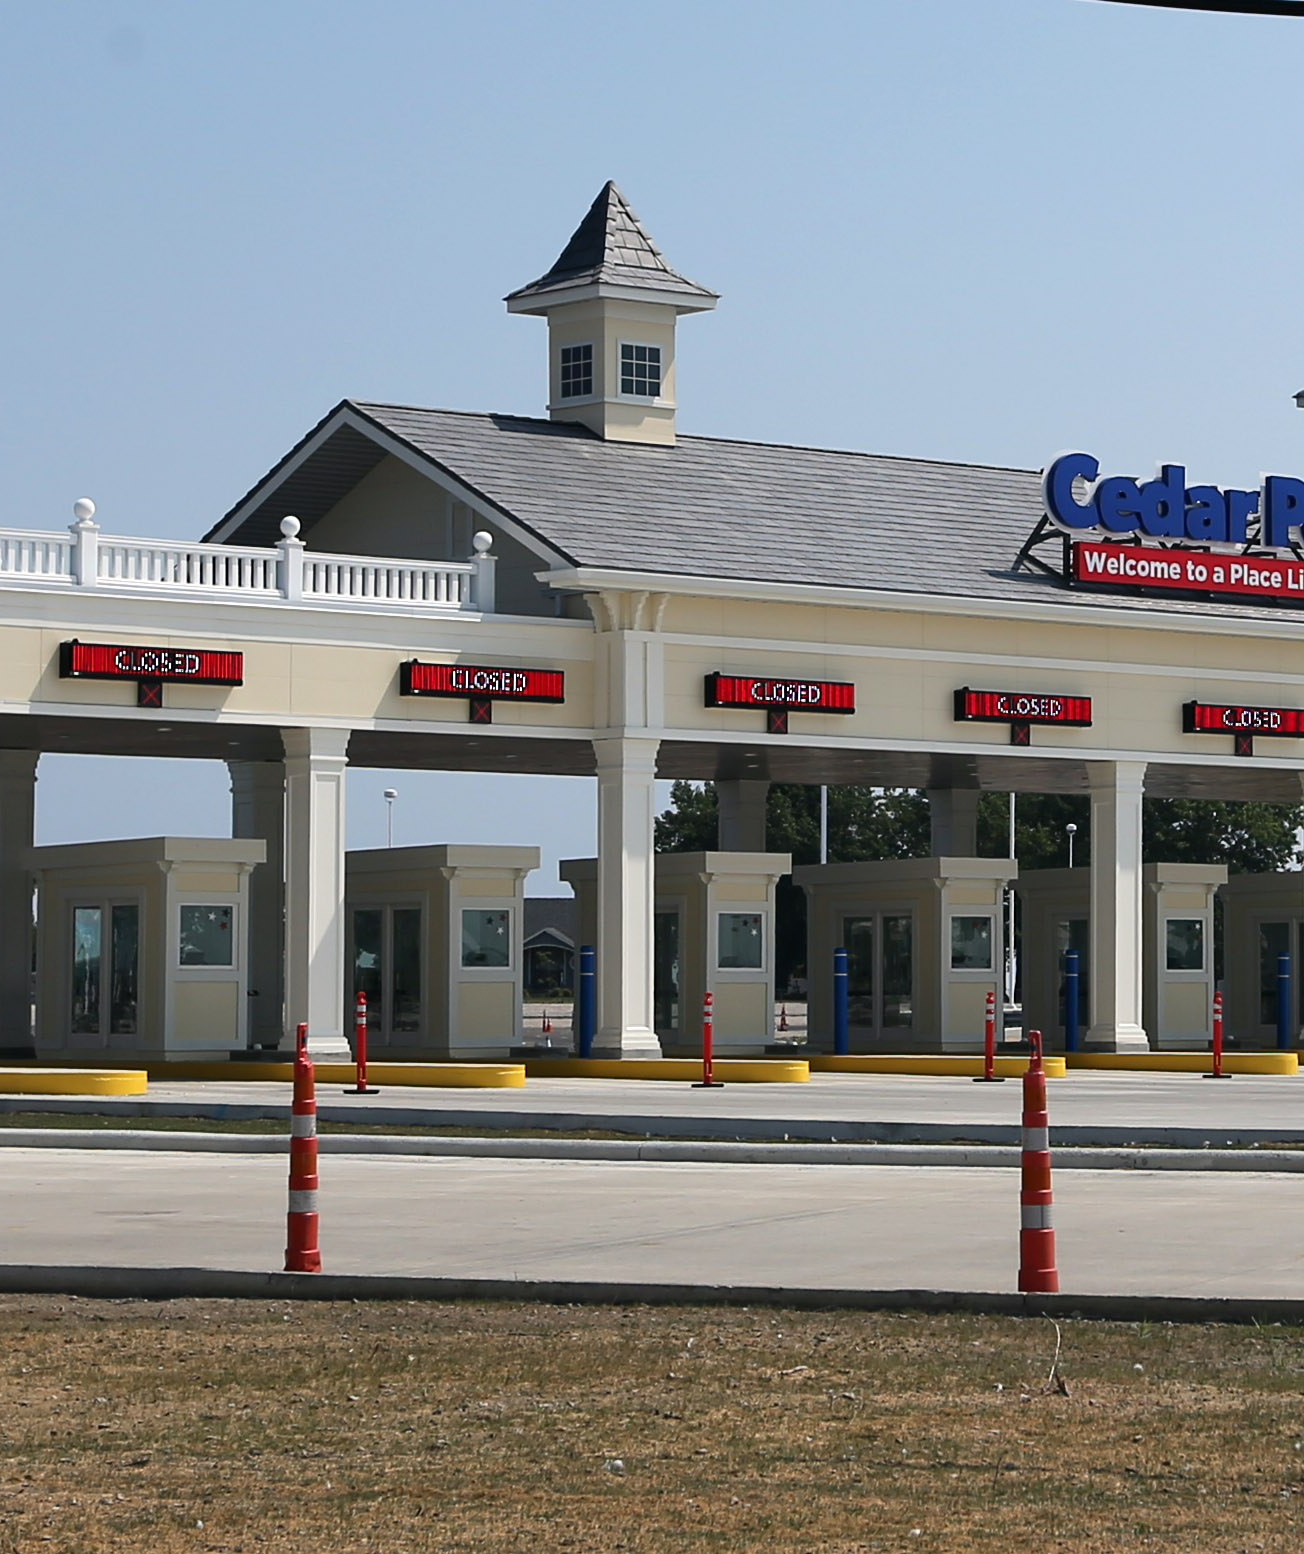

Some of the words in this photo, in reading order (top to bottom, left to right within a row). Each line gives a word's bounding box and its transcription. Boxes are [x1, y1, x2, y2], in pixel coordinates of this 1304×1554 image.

[1047, 453, 1259, 542] Cedar
[1084, 550, 1182, 580] Welcome
[1186, 560, 1209, 582] to
[1213, 566, 1225, 584] a
[1230, 563, 1283, 588] Place
[116, 650, 200, 674] CLOSED
[452, 669, 526, 692] CLOSED
[752, 682, 821, 703] CLOSED
